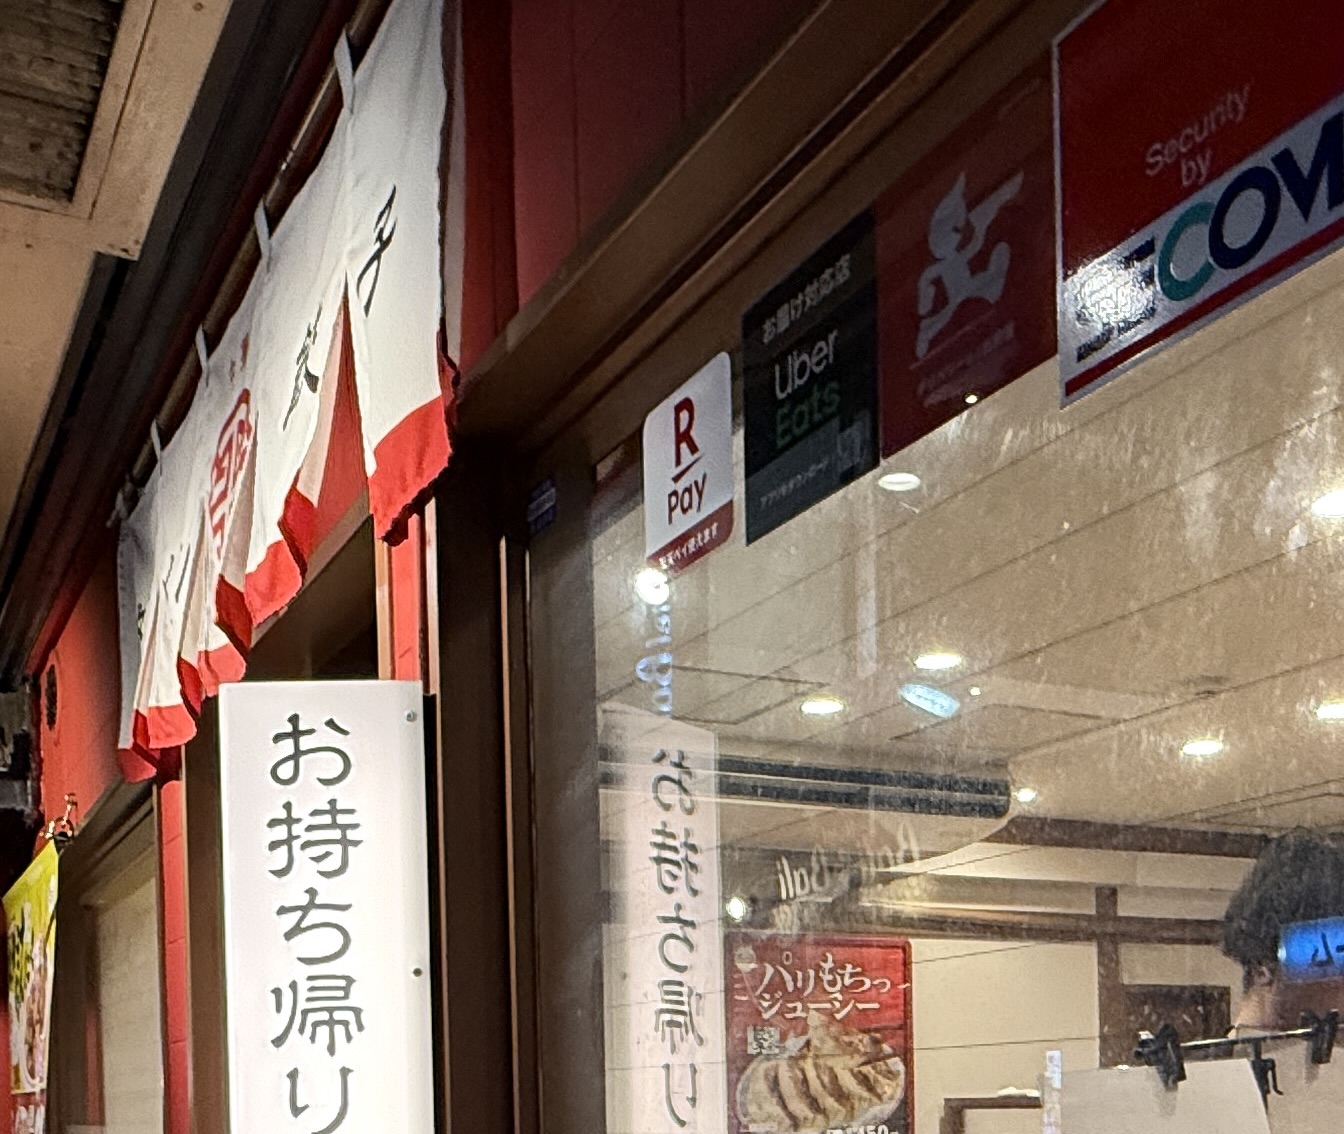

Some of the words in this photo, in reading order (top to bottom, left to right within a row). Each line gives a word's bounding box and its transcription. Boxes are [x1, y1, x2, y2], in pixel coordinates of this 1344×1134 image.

[1144, 83, 1251, 178] Security
[1180, 152, 1213, 187] by
[774, 329, 839, 400] Uber
[775, 380, 841, 449] Eats
[667, 473, 707, 526] Pay
[759, 990, 881, 1021] ジューシー
